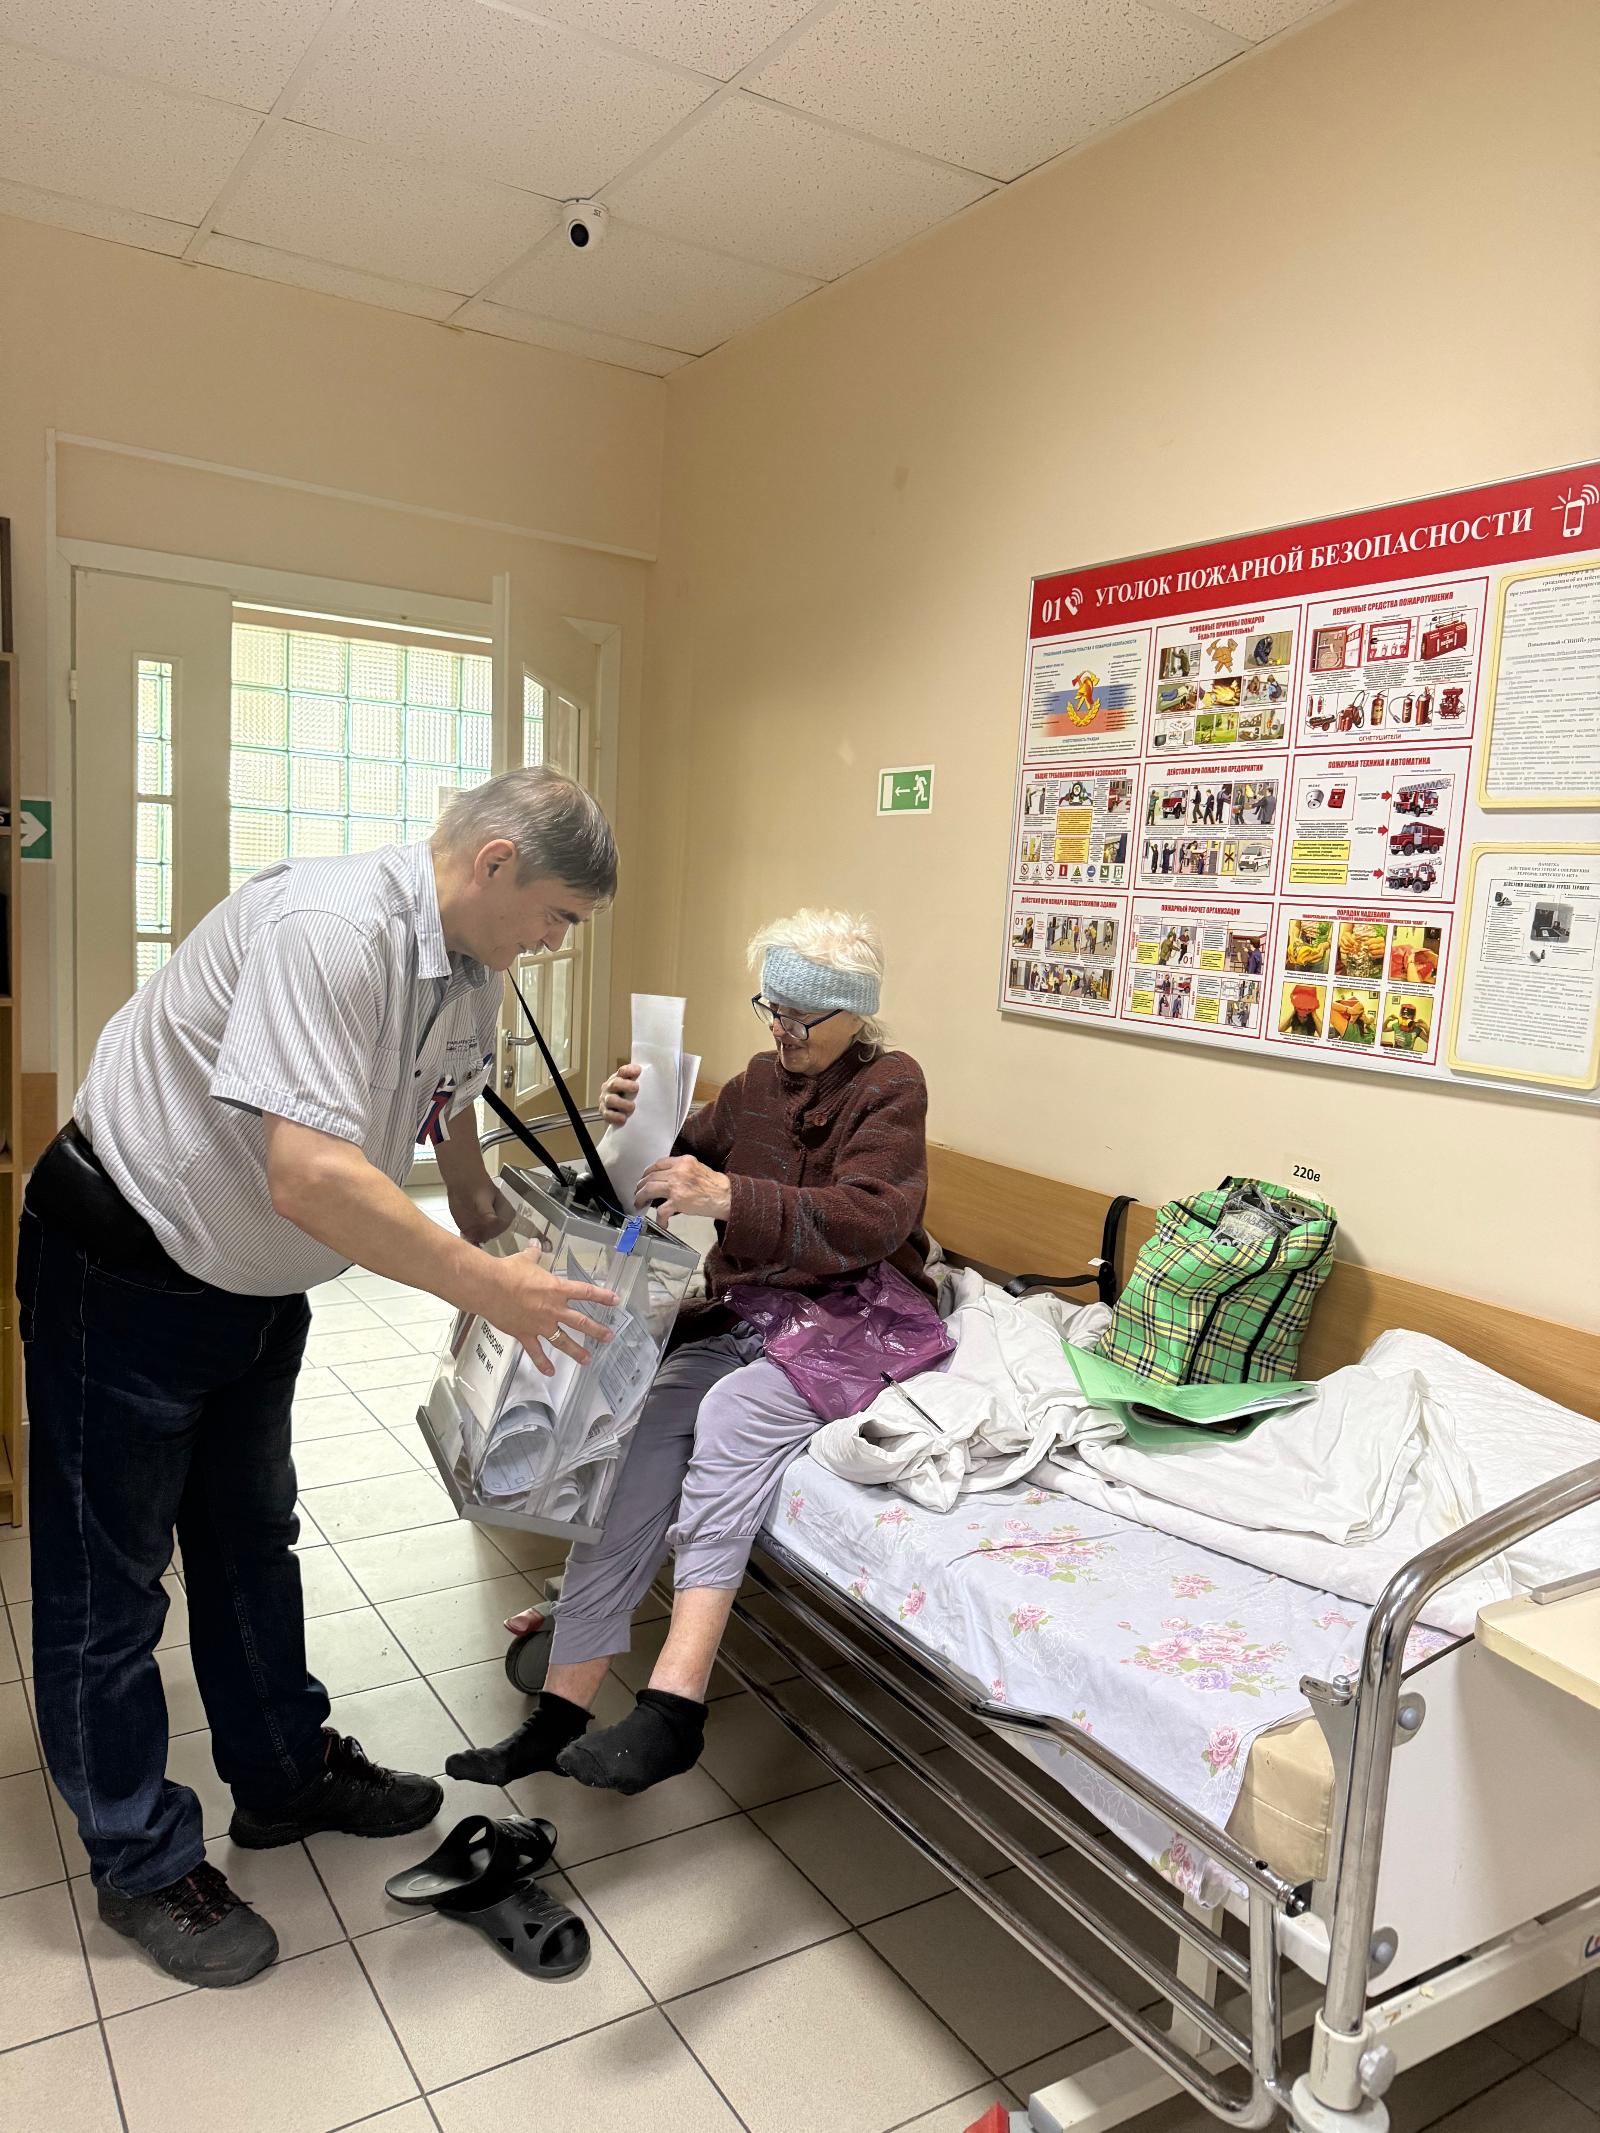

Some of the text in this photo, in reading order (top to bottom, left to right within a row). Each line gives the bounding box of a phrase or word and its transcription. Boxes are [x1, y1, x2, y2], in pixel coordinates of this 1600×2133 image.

[1095, 507, 1535, 607] УГОЛОК ПОЖАРНОЙ БЕЗОПАСНОСТИ
[1332, 591, 1454, 616] ПЕРВИЧНЫЕ СРЕДСТВА ПОЖАРОТУШЕНИЯ
[1041, 597, 1061, 623] 01
[1189, 615, 1265, 634] ОСНОВНЫЕ ПРИЧИНЫ ПОЖАРОВ
[1358, 734, 1402, 742] ОГНЕТУШИТЕЛИ
[1327, 757, 1431, 769] ПОЖАРНАЯ ТЕХНИКА И АВТОМАТИКА
[1166, 767, 1191, 776] ДЕЙСТВИЯ
[1190, 767, 1201, 775] ПРИ
[1201, 766, 1220, 774] ПОЖАРЕ
[1227, 764, 1264, 774] ПРЕДПРИЯТИИ
[1161, 904, 1188, 913] ПОЖАРНЫЙ
[1206, 906, 1241, 916] ОРГАНИЗАЦИИ
[1015, 917, 1024, 925] 01
[1183, 955, 1193, 964] 01
[1292, 1164, 1321, 1182] 220в
